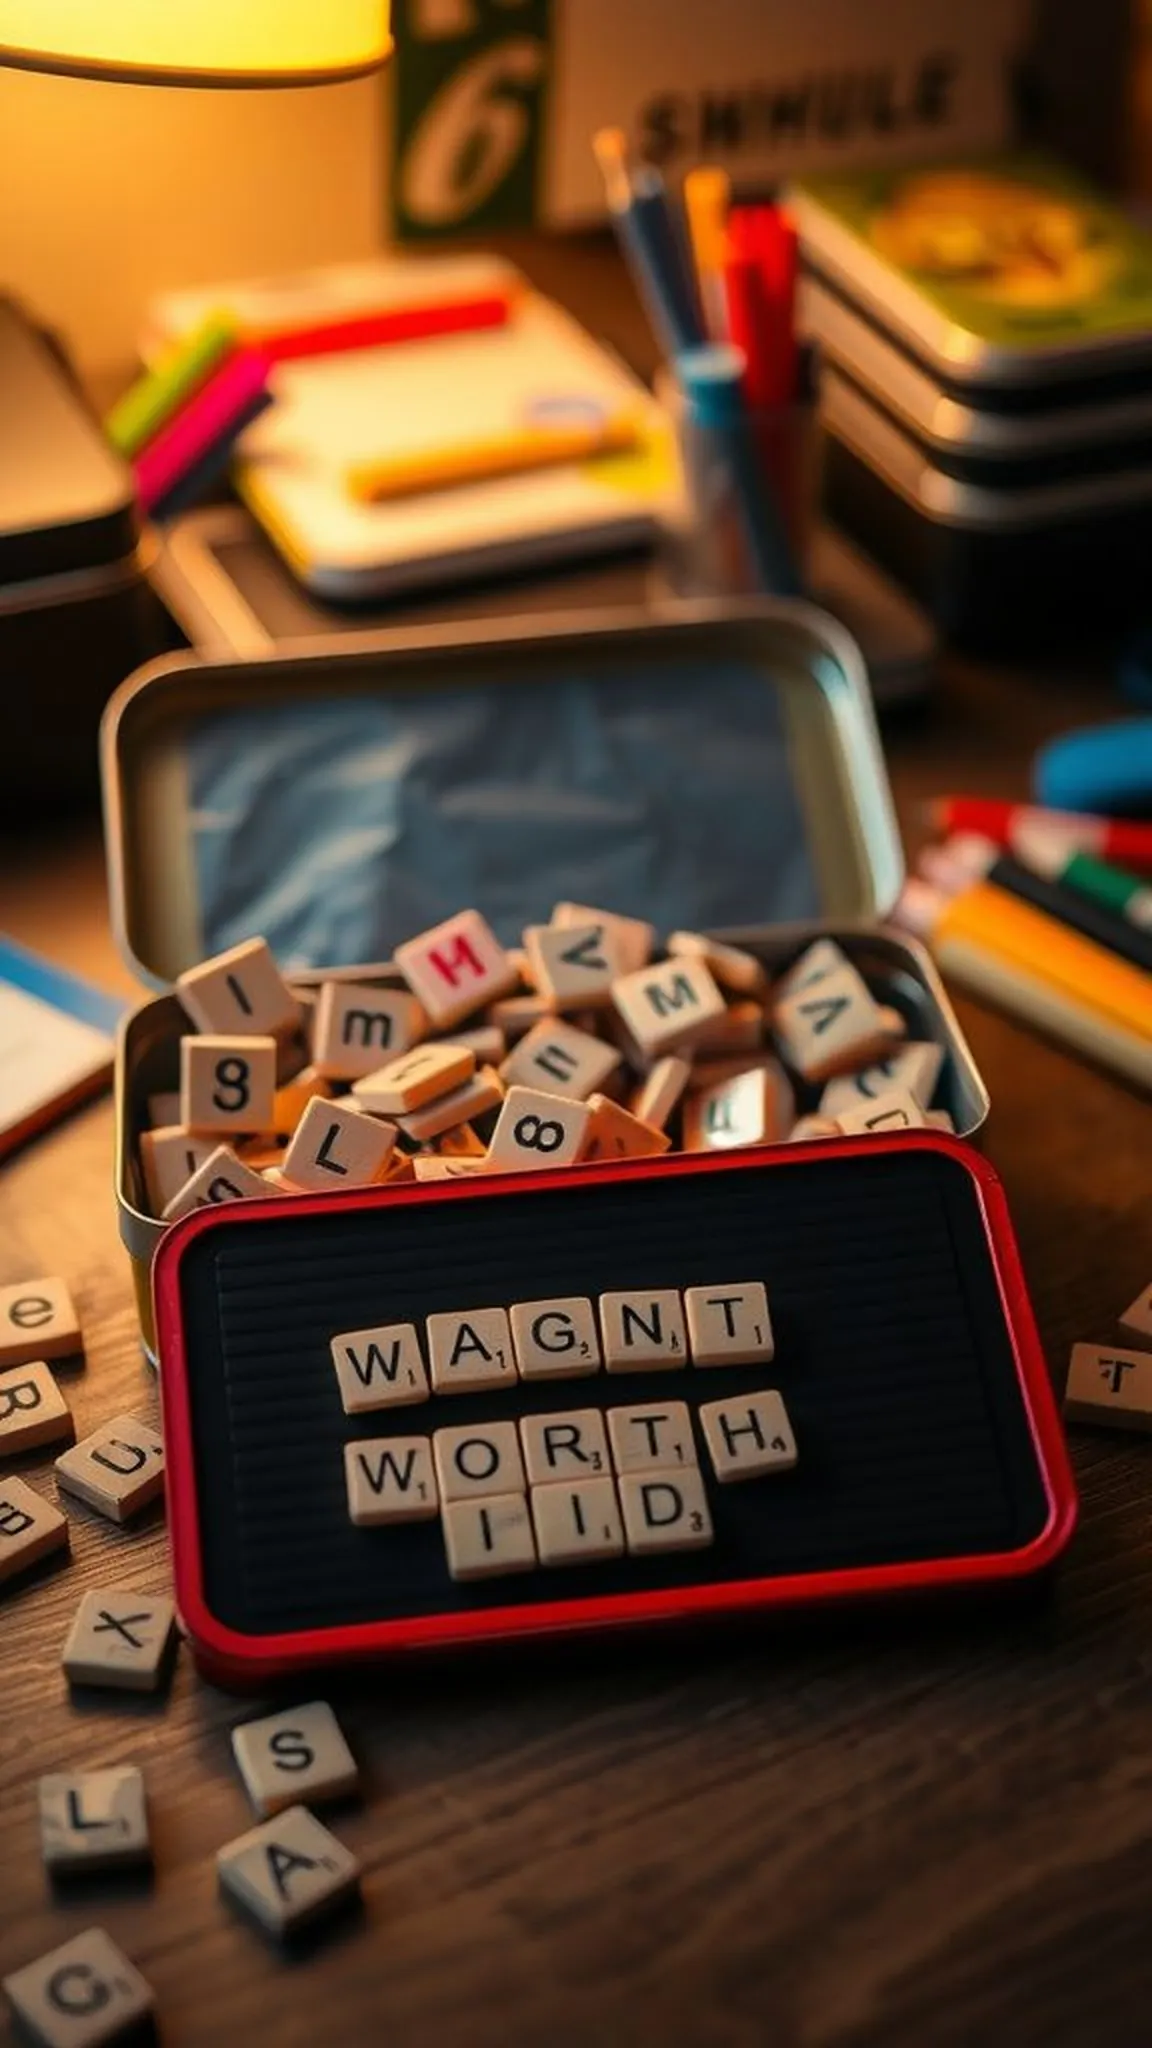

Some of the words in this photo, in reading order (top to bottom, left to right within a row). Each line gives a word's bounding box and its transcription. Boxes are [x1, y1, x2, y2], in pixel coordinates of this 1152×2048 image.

[404, 42, 538, 224] 6
[314, 1123, 348, 1176] L
[345, 1297, 745, 1387] WAGNT
[357, 1409, 768, 1496] WORTH
[93, 1610, 152, 1648] X
[269, 1731, 314, 1772] S
[68, 1789, 112, 1830] L
[266, 1842, 317, 1903] A
